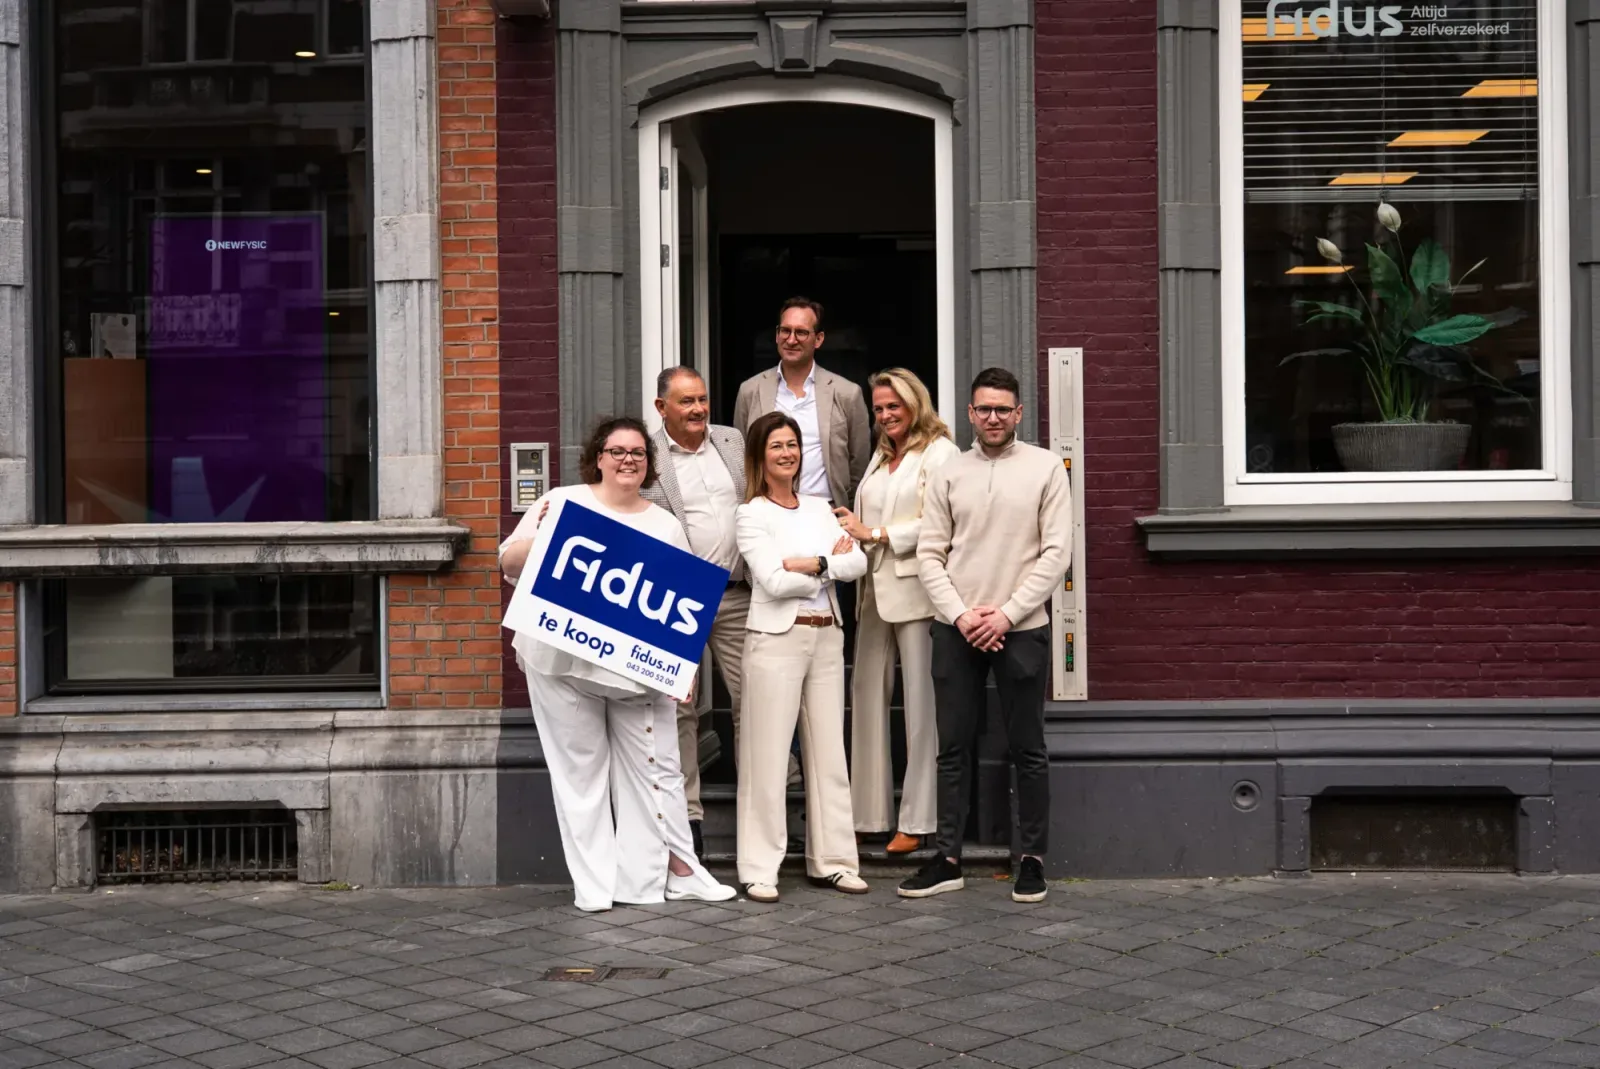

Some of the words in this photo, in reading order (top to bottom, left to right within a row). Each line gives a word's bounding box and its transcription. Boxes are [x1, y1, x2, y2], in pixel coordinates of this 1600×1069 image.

[1410, 5, 1447, 21] Altijd
[1410, 22, 1510, 36] zelfverzekerd
[217, 241, 267, 249] NEWFYSIC
[538, 611, 558, 632] te
[563, 618, 615, 658] koop
[630, 644, 681, 676] fidus.nl
[626, 661, 640, 672] 043
[641, 668, 655, 678] 200
[655, 674, 664, 682] 52
[665, 678, 674, 686] 00
